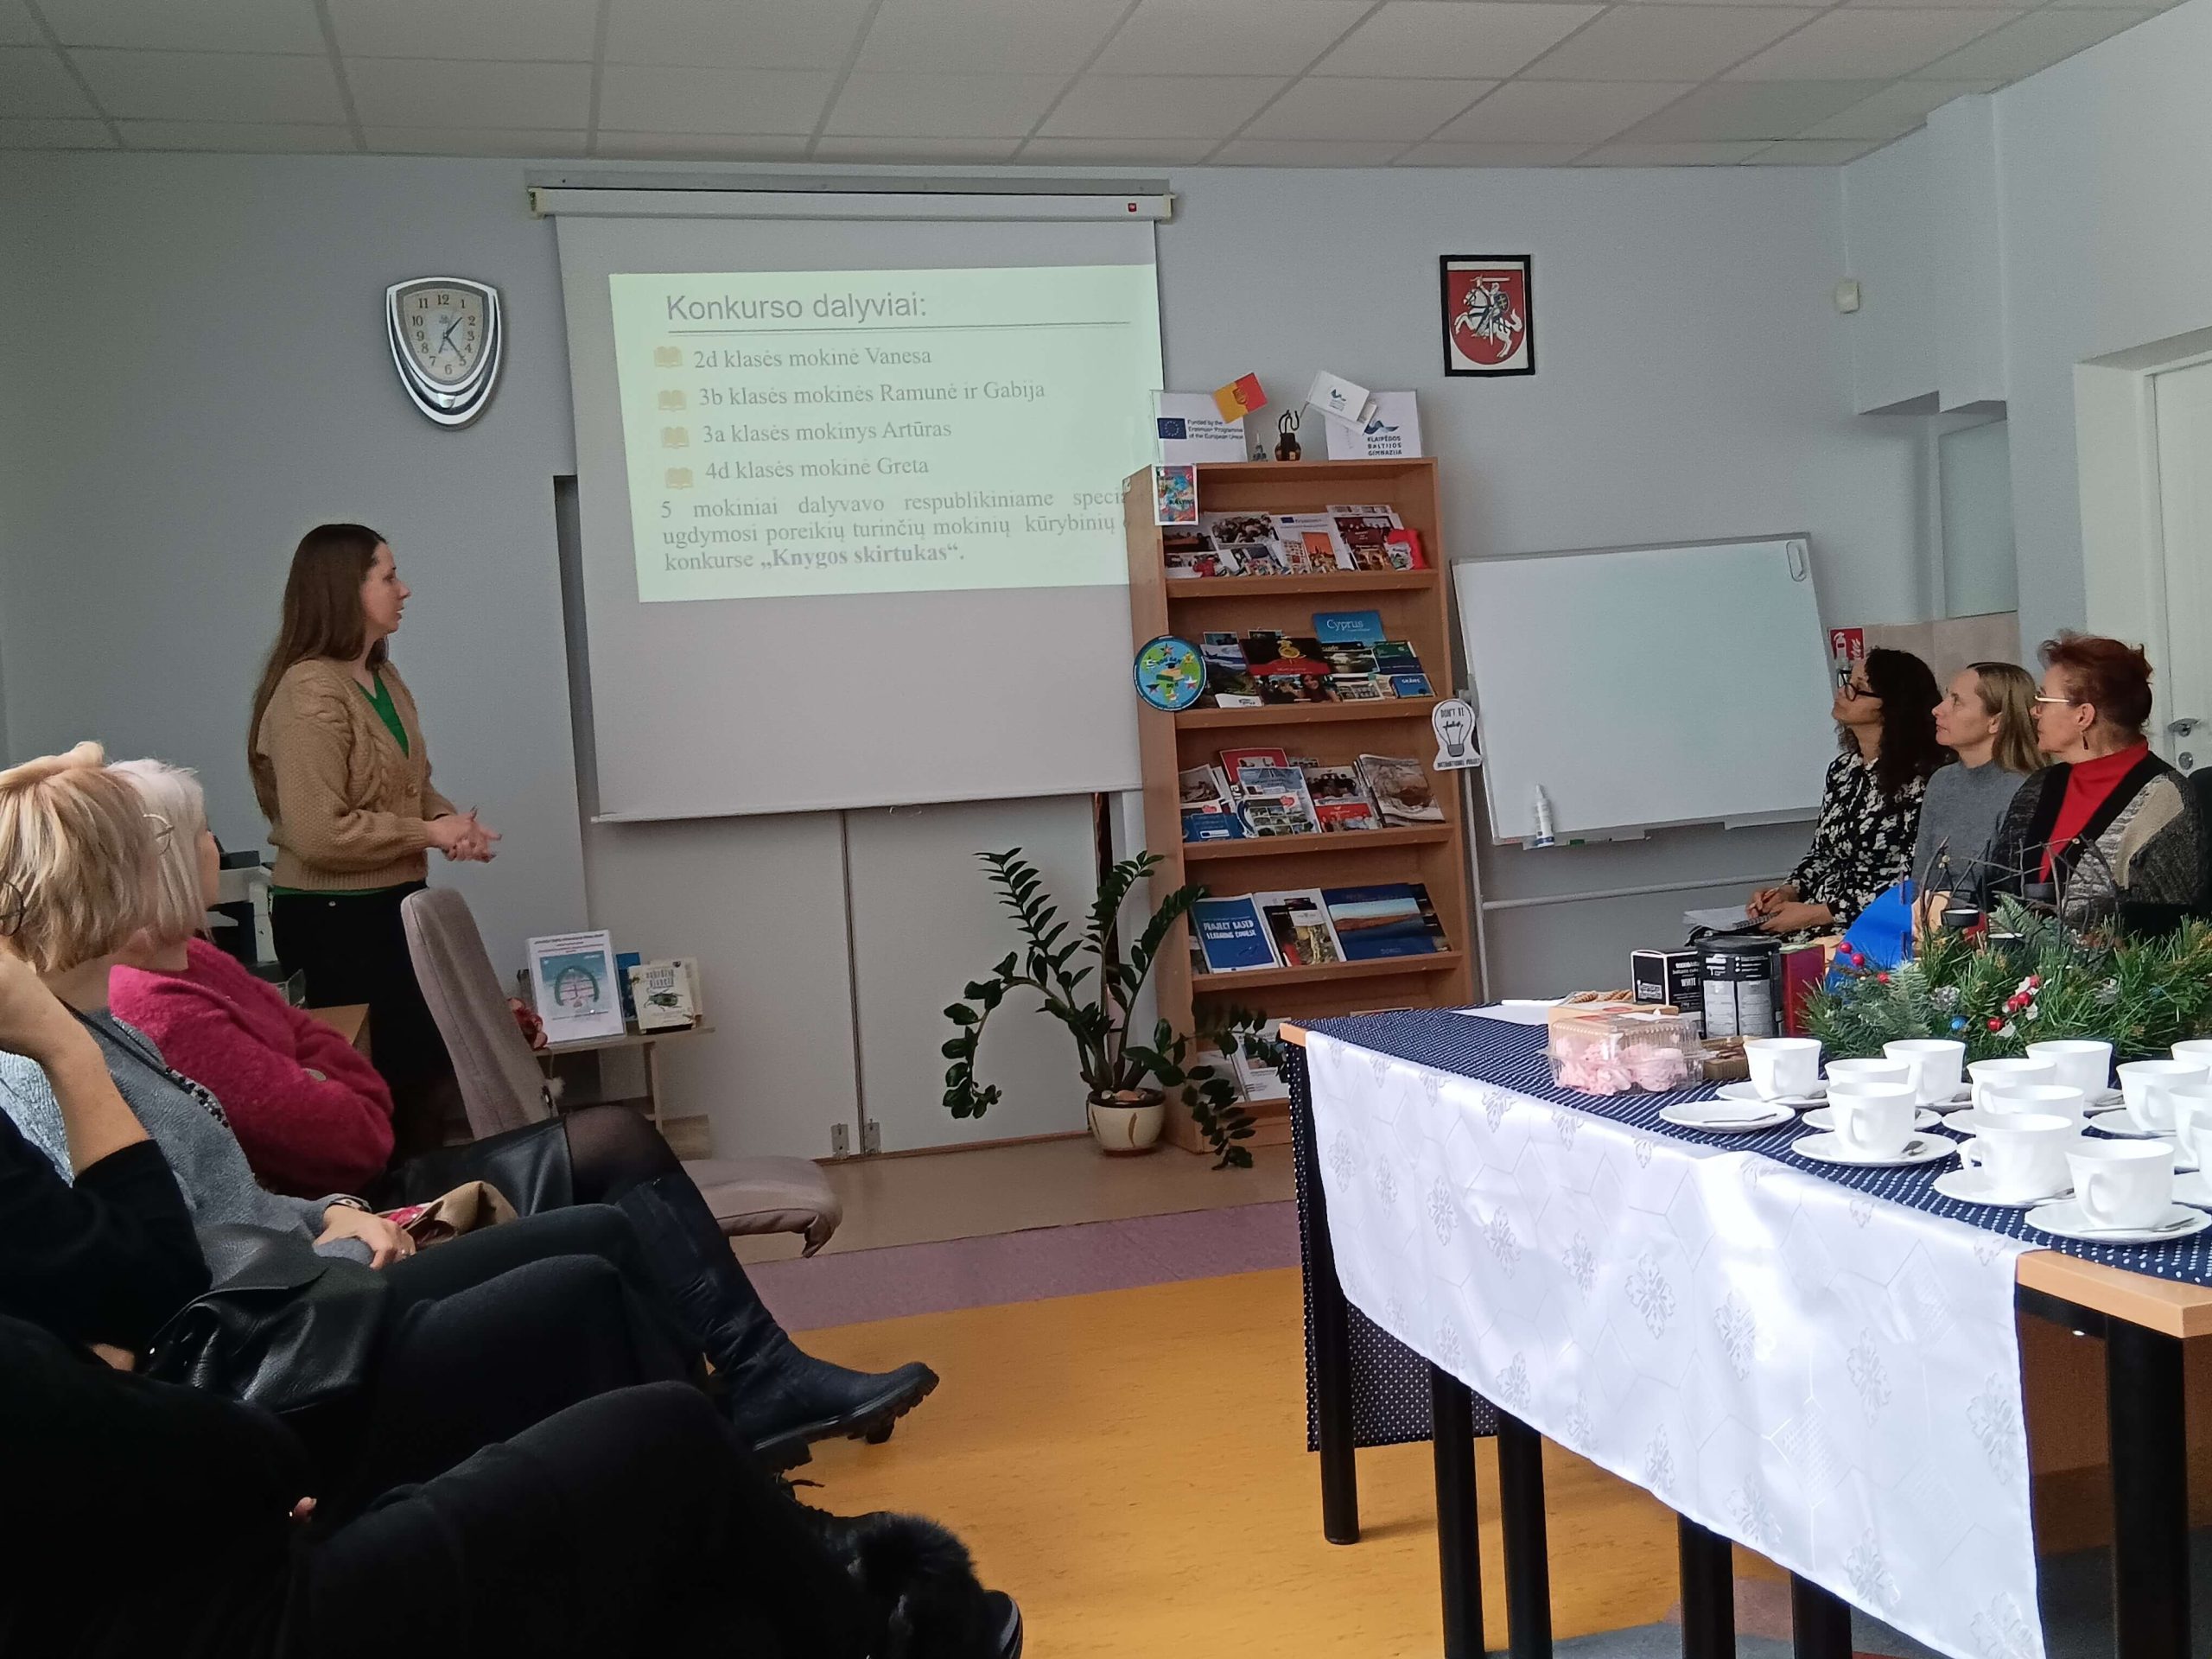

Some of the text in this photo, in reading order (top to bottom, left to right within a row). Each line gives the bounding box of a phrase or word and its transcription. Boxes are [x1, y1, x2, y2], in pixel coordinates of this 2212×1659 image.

[418, 298, 429, 308] 11
[437, 295, 449, 305] 12
[461, 299, 466, 308] 1
[666, 291, 927, 323] Konkurso dalyviai:
[412, 315, 423, 326] 10
[467, 315, 476, 326] 2
[416, 330, 424, 341] 9
[467, 330, 474, 341] 3
[422, 342, 429, 353] 8
[465, 344, 472, 353] 4
[429, 356, 436, 366] 7
[459, 357, 467, 366] 5
[694, 347, 931, 369] 2d klasės mokinė Vanesa
[445, 365, 452, 375] 6
[699, 380, 1045, 406] 3b klasės mokinės Ramunė ir Gabija
[702, 421, 951, 444] 3a klasės mokinys Artūras
[705, 457, 929, 480] 4d klasės mokinė Greta
[661, 500, 672, 518] 5
[693, 498, 778, 518] mokiniai
[798, 495, 885, 517] dalyvavo
[905, 490, 1054, 514] respublikiniame
[663, 512, 1115, 550] ugdymosi poreikių turinčių mokinių kūrybinių
[664, 553, 754, 571] konkurse
[760, 548, 848, 570] „Knygos
[1326, 619, 1364, 632] Cyprus
[1203, 921, 1230, 931] PROJECT
[1232, 919, 1255, 929] BASED
